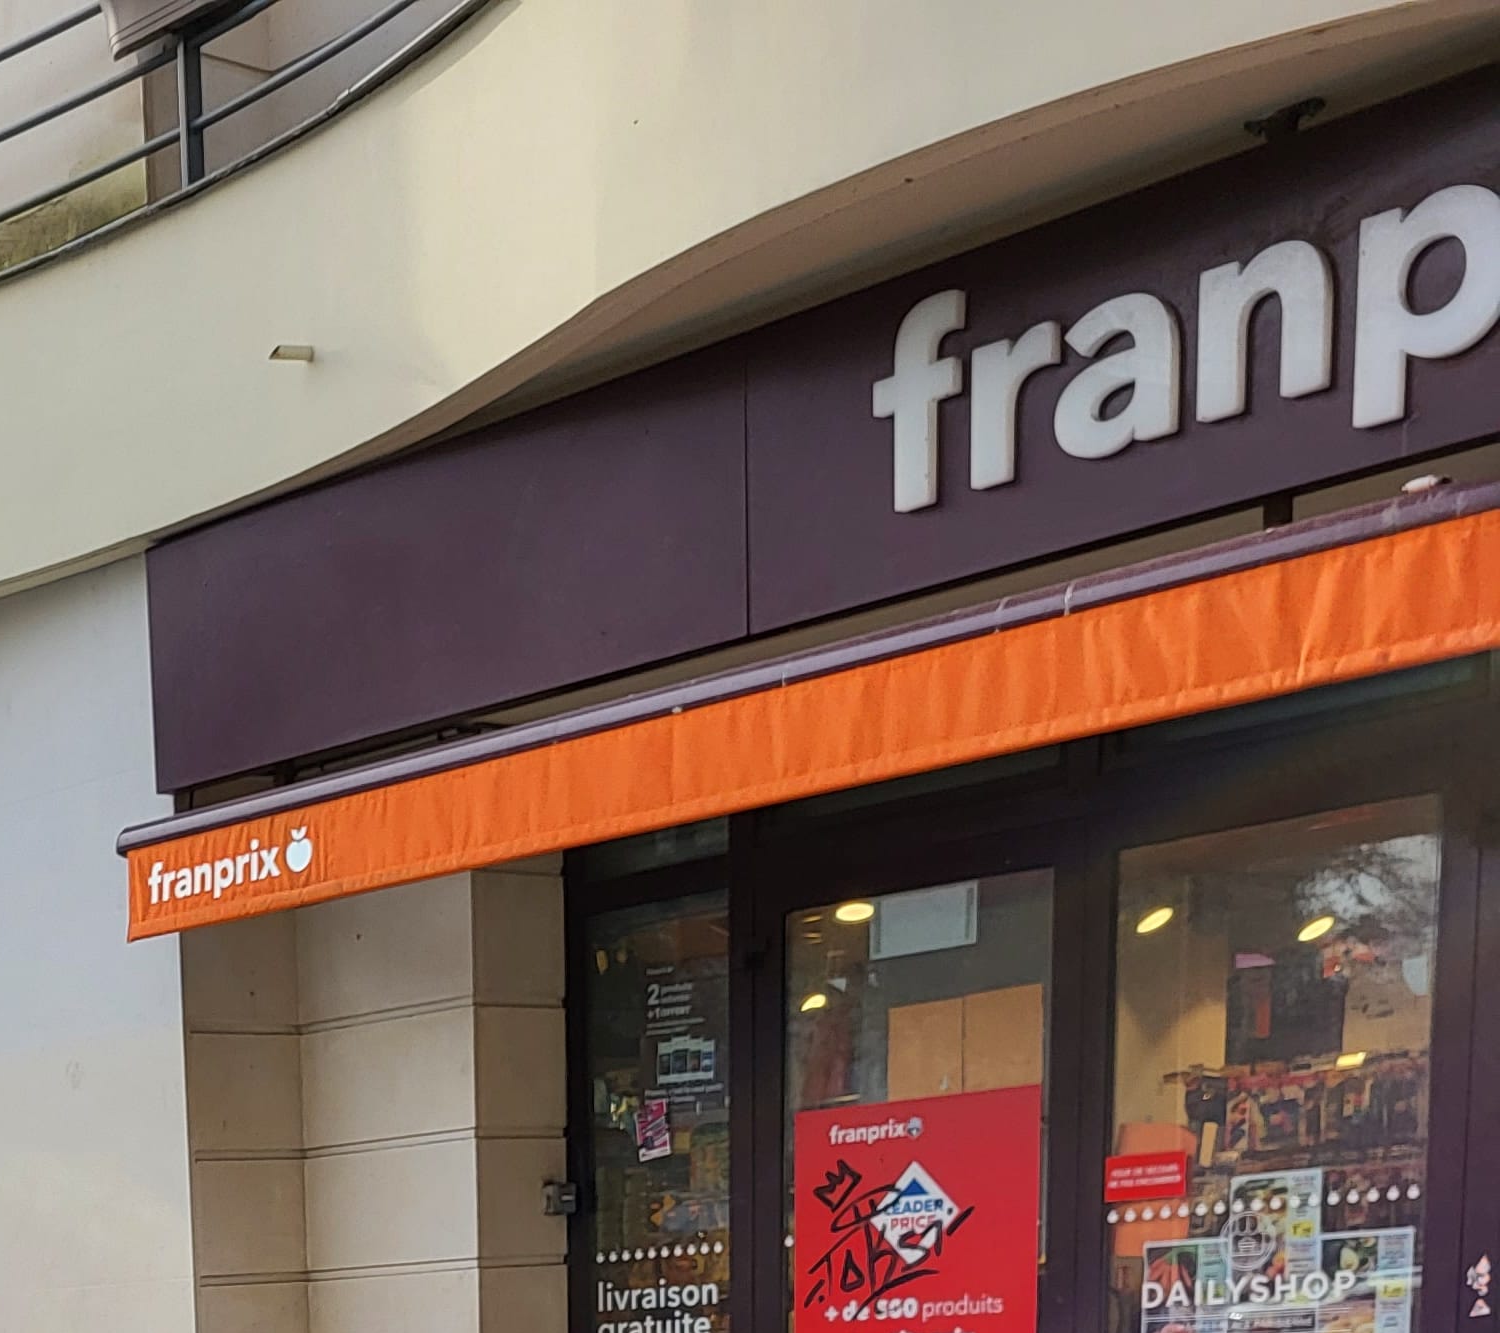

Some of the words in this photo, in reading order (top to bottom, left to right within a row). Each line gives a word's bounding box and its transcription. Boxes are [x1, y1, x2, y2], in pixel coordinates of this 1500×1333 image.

[873, 184, 1500, 513] franp
[148, 839, 282, 905] franprix
[829, 1119, 905, 1146] franprix
[890, 1214, 937, 1231] PRICE
[597, 1278, 719, 1312] livraison
[1141, 1269, 1357, 1310] DAILYSHOP
[842, 1299, 870, 1322] de
[922, 1293, 1004, 1323] produits
